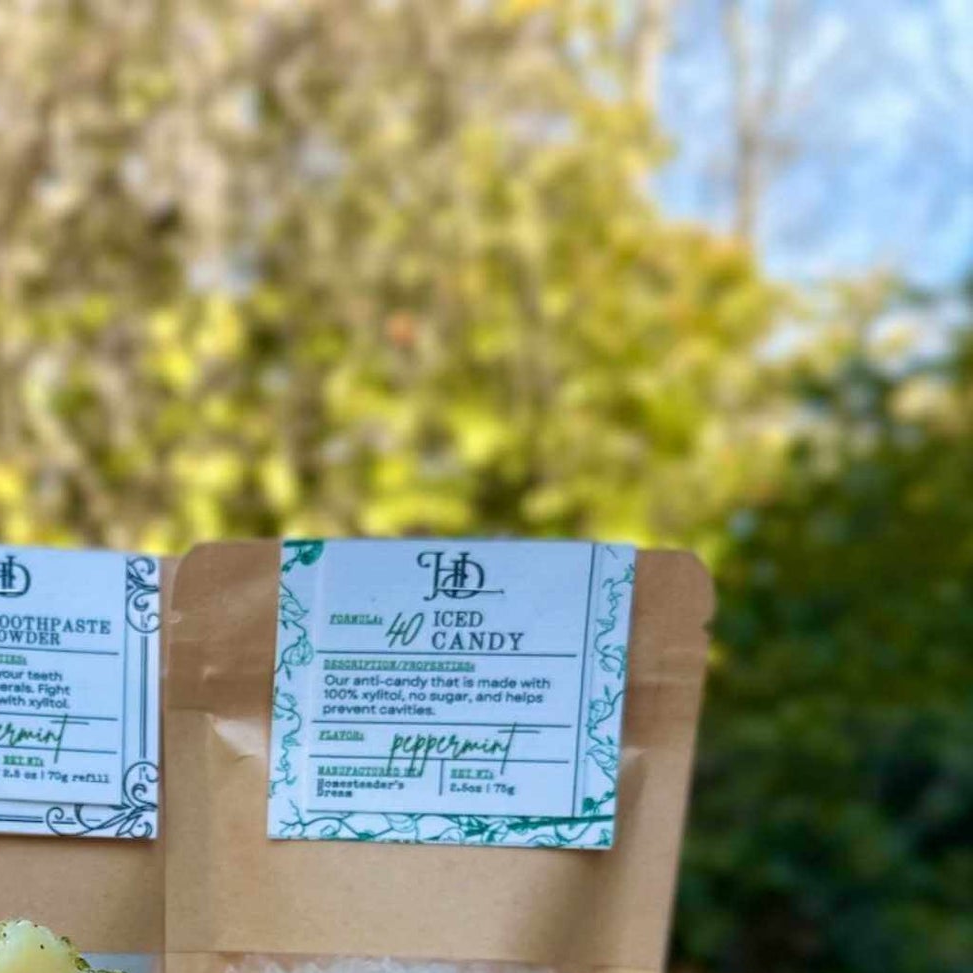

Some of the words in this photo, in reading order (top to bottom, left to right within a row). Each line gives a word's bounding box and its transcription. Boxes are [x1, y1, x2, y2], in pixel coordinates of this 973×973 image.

[433, 610, 483, 628] ICED
[385, 611, 424, 649] 40
[432, 632, 525, 652] CANDY
[27, 671, 63, 682] teeth
[325, 675, 349, 687] Our
[353, 675, 427, 690] anti-candy
[431, 677, 459, 688] that
[462, 677, 474, 689] is
[477, 678, 517, 689] made
[520, 678, 551, 690] with
[38, 684, 71, 698] Fight
[324, 689, 358, 700] 100%
[361, 689, 405, 703] xylitol,
[408, 692, 426, 701] no
[429, 692, 473, 705] sugar,
[475, 691, 502, 702] and
[505, 692, 544, 704] helps
[28, 696, 71, 710] xylitol.
[322, 704, 377, 716] prevent
[379, 703, 436, 716] cavities.
[387, 722, 541, 777] peppermint
[71, 773, 110, 784] refill
